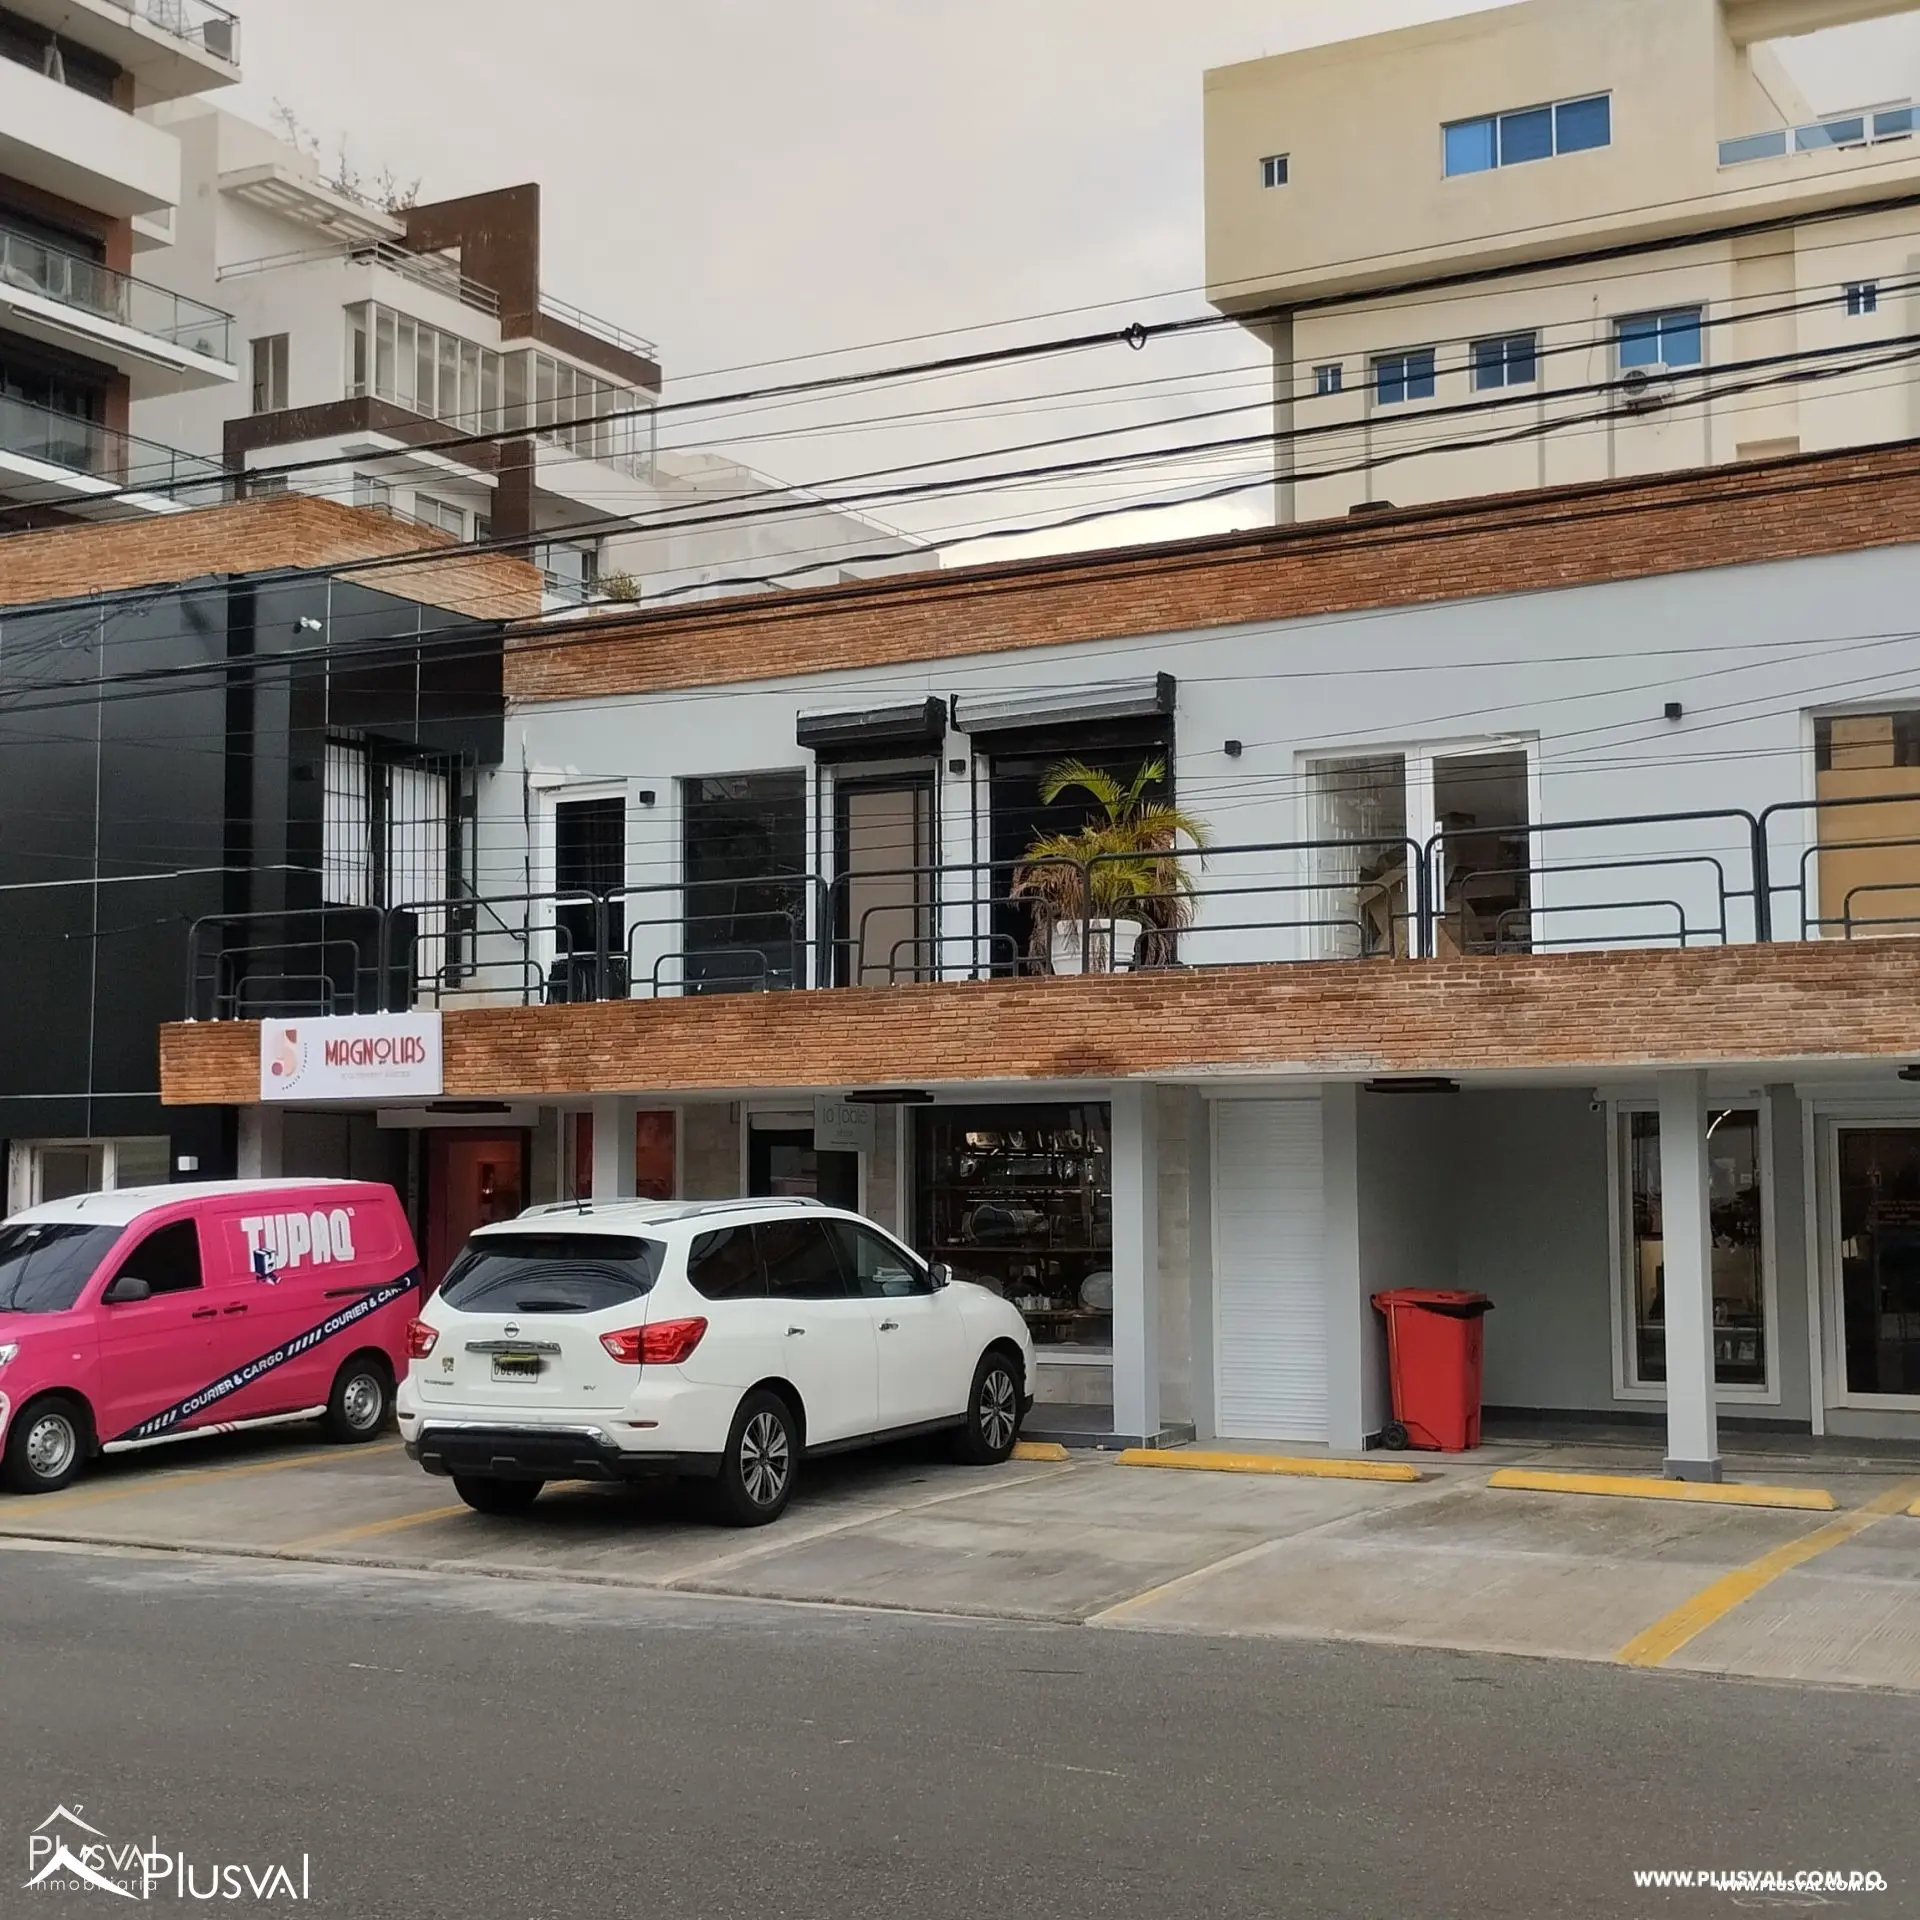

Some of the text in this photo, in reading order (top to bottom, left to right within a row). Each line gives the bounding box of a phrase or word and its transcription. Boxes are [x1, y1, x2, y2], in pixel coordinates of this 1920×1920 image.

[325, 1036, 426, 1066] MAGNOLIAS
[324, 1301, 369, 1333] COURIER
[369, 1297, 377, 1308] &
[182, 1351, 284, 1414] COURIER & CARGO
